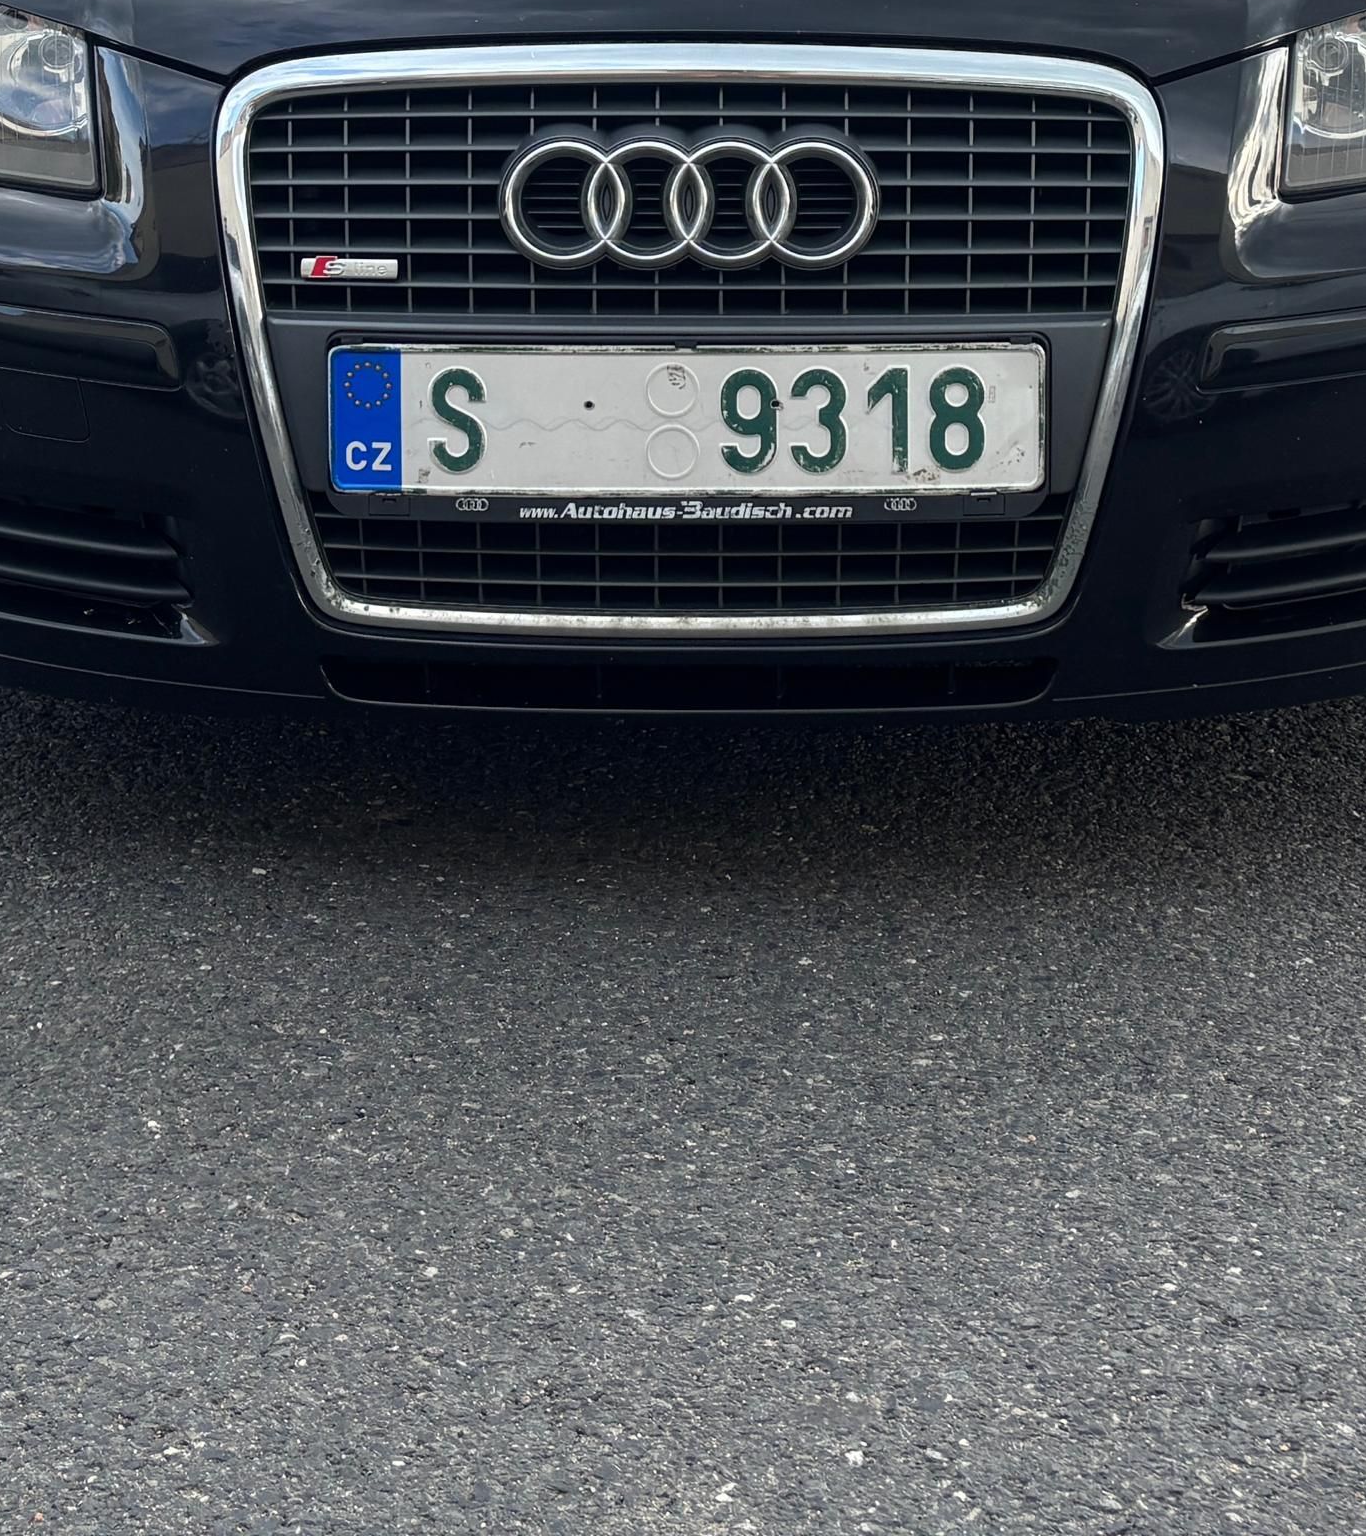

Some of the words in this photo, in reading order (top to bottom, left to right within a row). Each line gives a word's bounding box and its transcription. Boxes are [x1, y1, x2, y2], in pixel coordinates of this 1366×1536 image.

[322, 260, 346, 276] S
[428, 366, 487, 474] S
[719, 365, 986, 474] 9318
[345, 440, 392, 472] CZ
